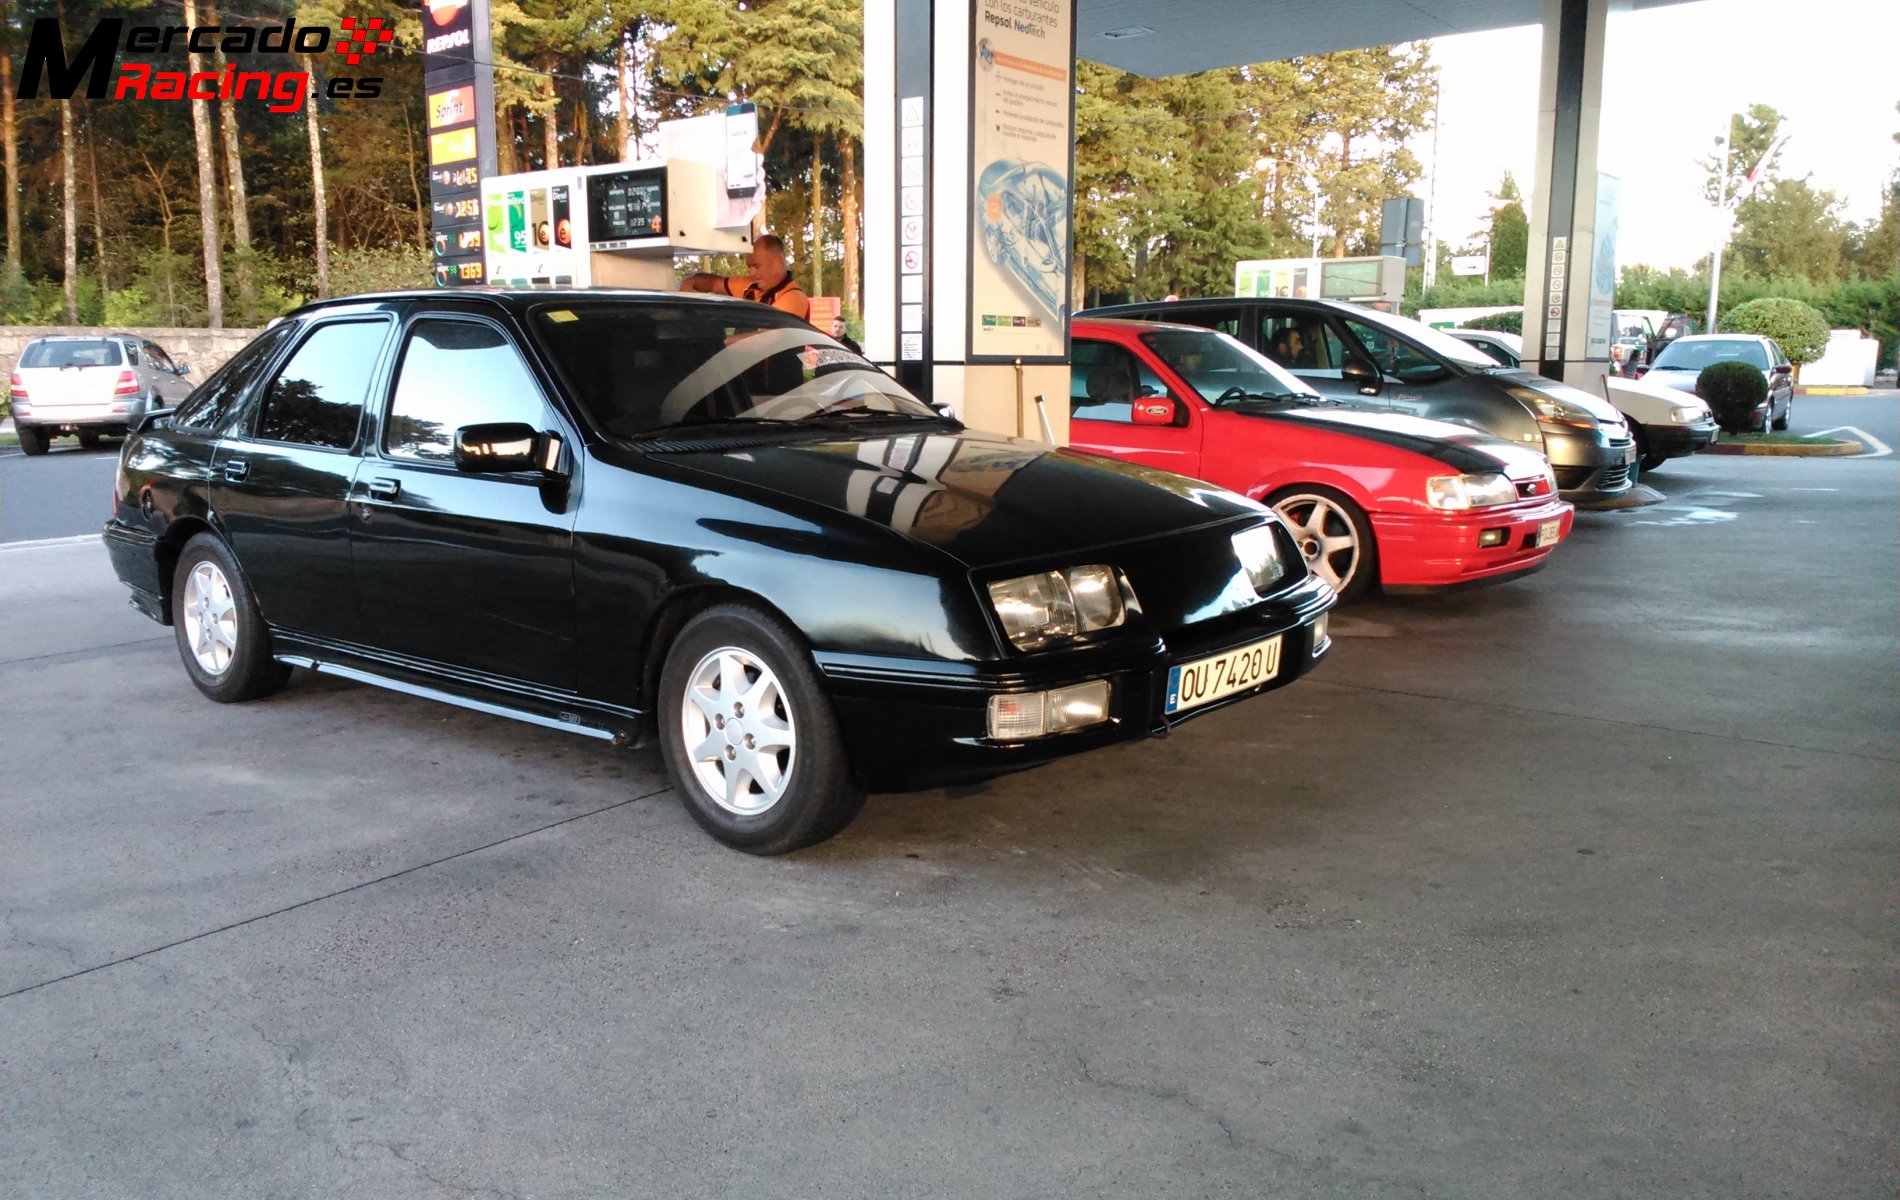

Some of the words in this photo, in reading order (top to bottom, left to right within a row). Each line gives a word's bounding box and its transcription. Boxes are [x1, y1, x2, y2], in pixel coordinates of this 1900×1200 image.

[984, 10, 1012, 30] Repsol
[1013, 6, 1058, 28] carburantes
[426, 29, 470, 54] REPSOL
[436, 101, 464, 122] Sprint
[1181, 663, 1209, 702] OU
[1212, 648, 1263, 695] 7420
[1266, 642, 1278, 676] U
[1169, 693, 1177, 705] E
